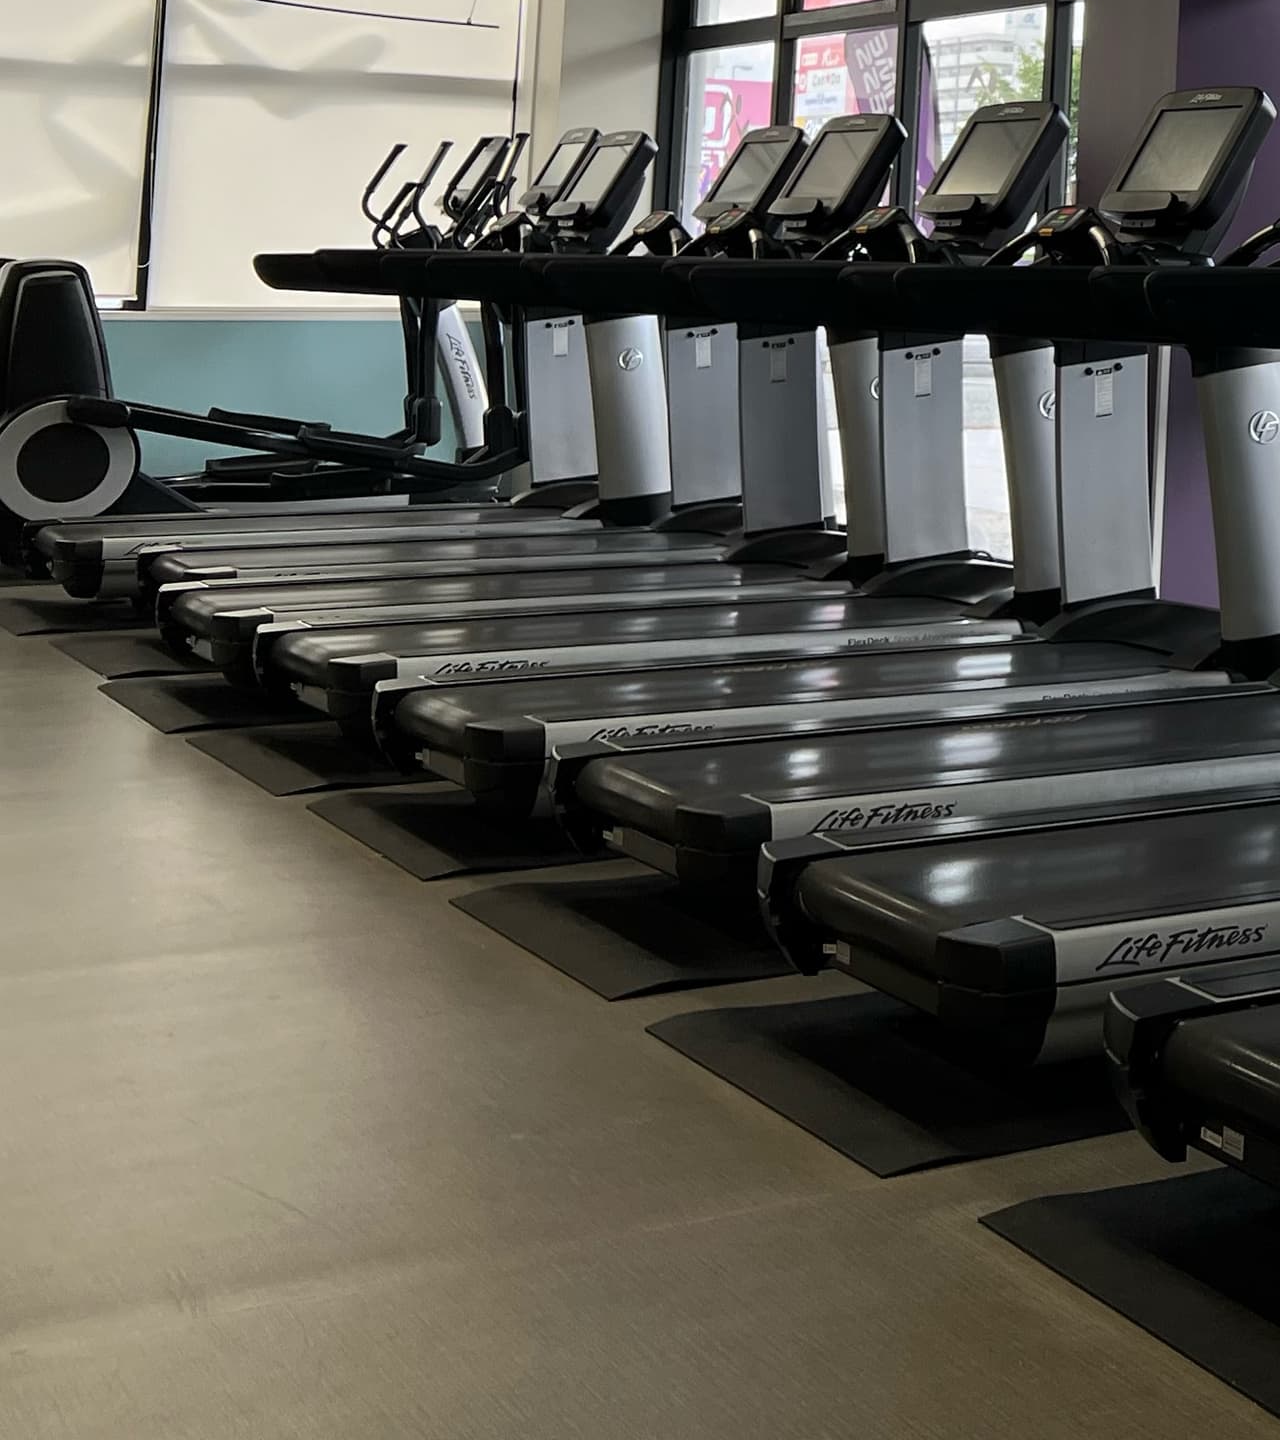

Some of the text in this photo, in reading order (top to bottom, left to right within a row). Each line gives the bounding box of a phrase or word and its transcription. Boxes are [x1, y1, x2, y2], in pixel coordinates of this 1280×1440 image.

[862, 803, 957, 828] Fitness
[1096, 925, 1266, 971] Life Fitness
